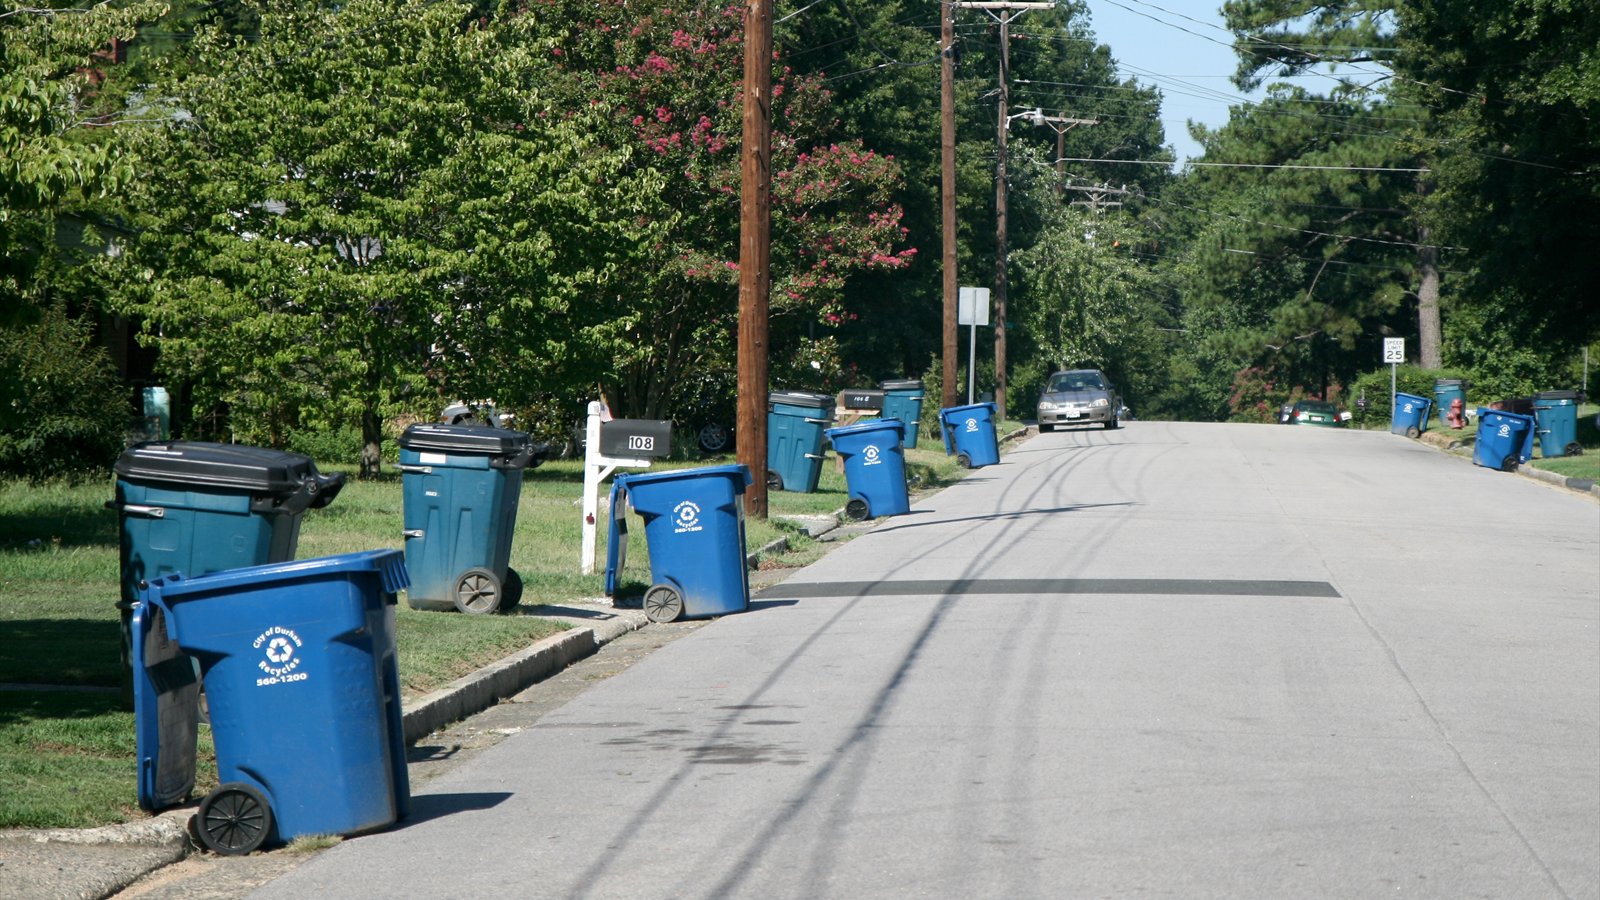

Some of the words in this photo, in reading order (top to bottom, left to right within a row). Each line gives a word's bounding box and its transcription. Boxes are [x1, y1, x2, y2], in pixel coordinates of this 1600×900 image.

[1386, 350, 1403, 360] 25
[630, 437, 652, 449] 108
[253, 633, 266, 649] City
[265, 627, 274, 637] of
[274, 626, 302, 648] Durham
[258, 658, 299, 676] Recycles
[257, 673, 307, 686] 560-1200
